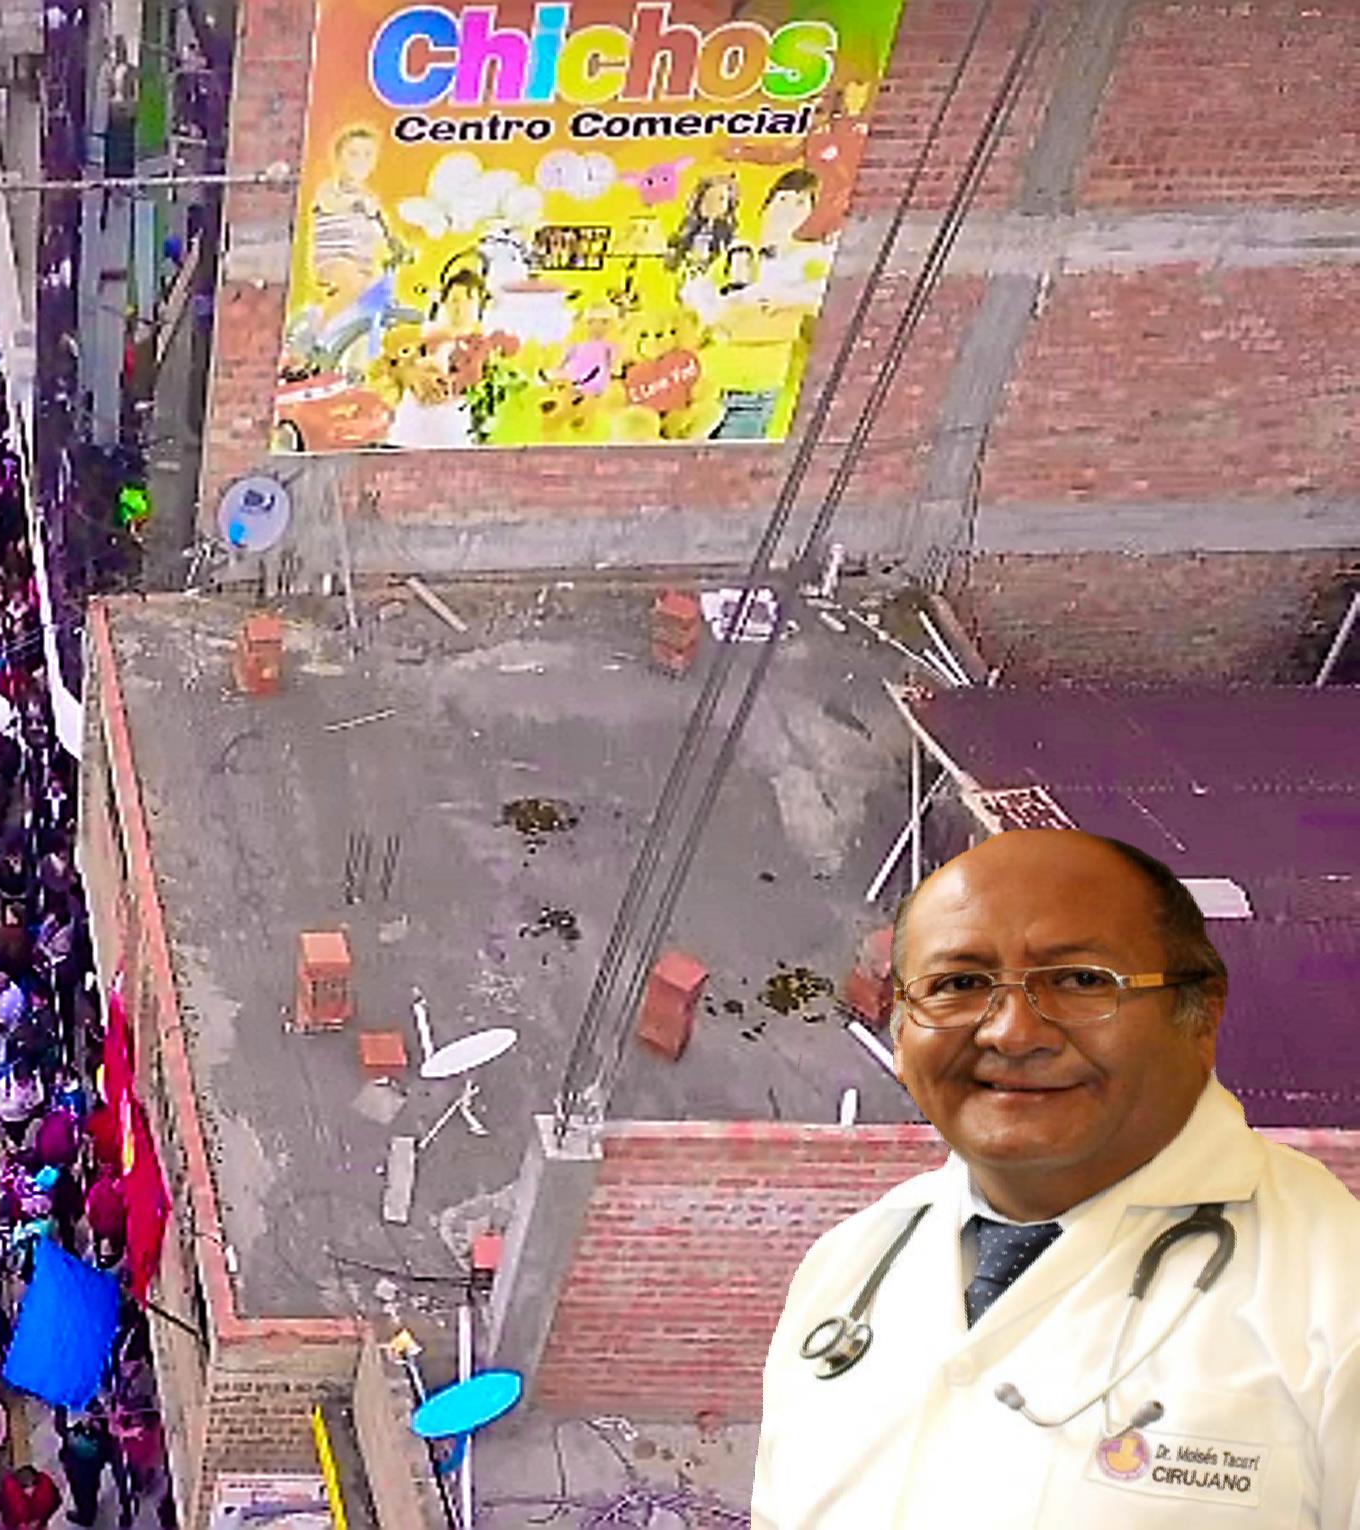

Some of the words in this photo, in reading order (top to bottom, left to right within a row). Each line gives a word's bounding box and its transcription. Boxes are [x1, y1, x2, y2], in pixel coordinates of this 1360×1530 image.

[368, 2, 838, 107] Chichos
[394, 112, 552, 143] Centro
[570, 106, 812, 140] Comercial
[1155, 1443, 1172, 1461] Dr.
[1176, 1446, 1218, 1466] Moisés
[1152, 1466, 1252, 1493] CIRUJANO
